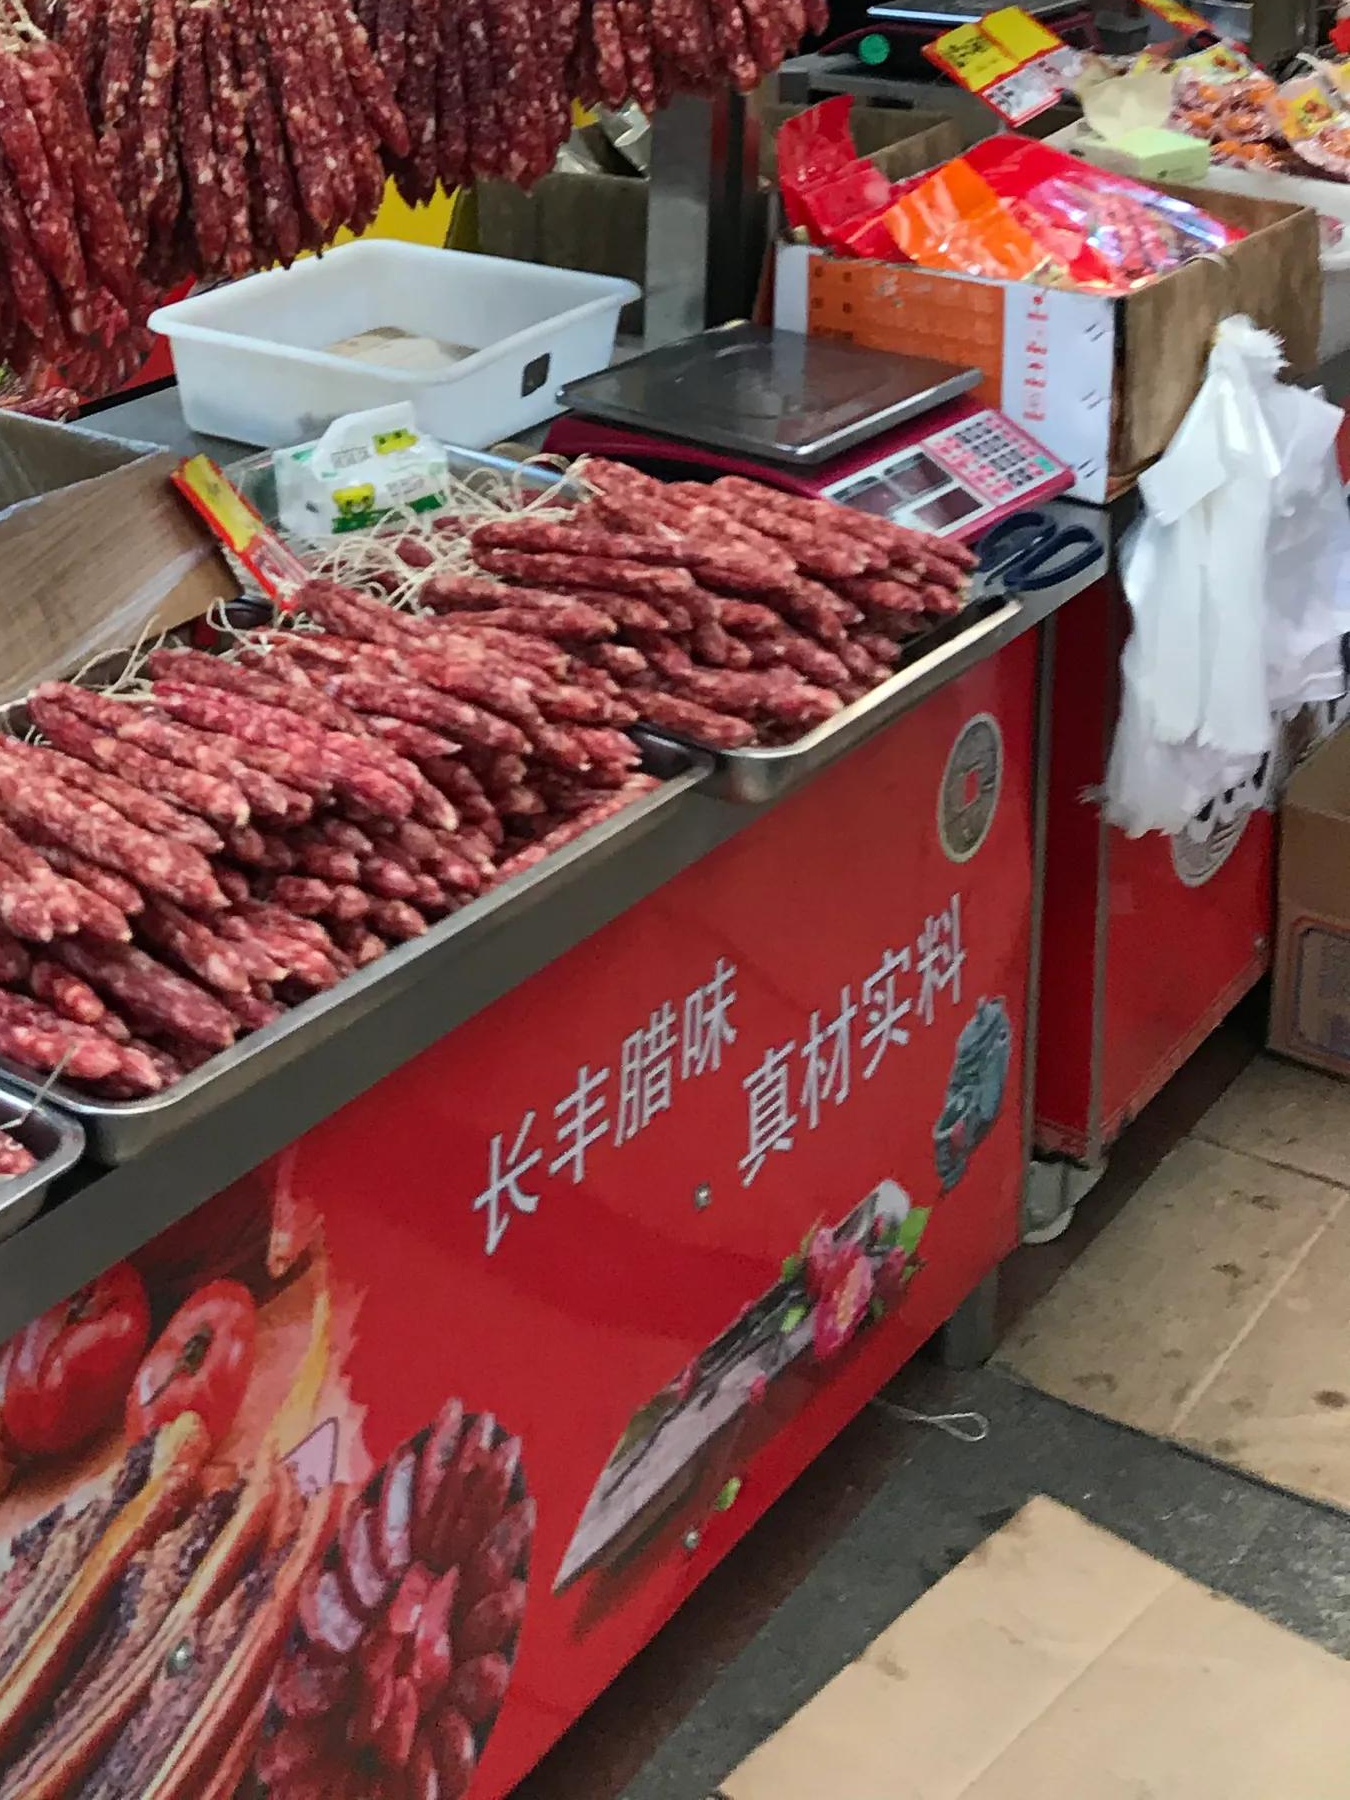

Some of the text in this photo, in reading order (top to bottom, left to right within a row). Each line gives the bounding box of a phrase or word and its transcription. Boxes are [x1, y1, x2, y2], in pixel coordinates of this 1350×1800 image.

[471, 955, 738, 1257] 长丰腊味
[738, 892, 968, 1188] 真材实料
